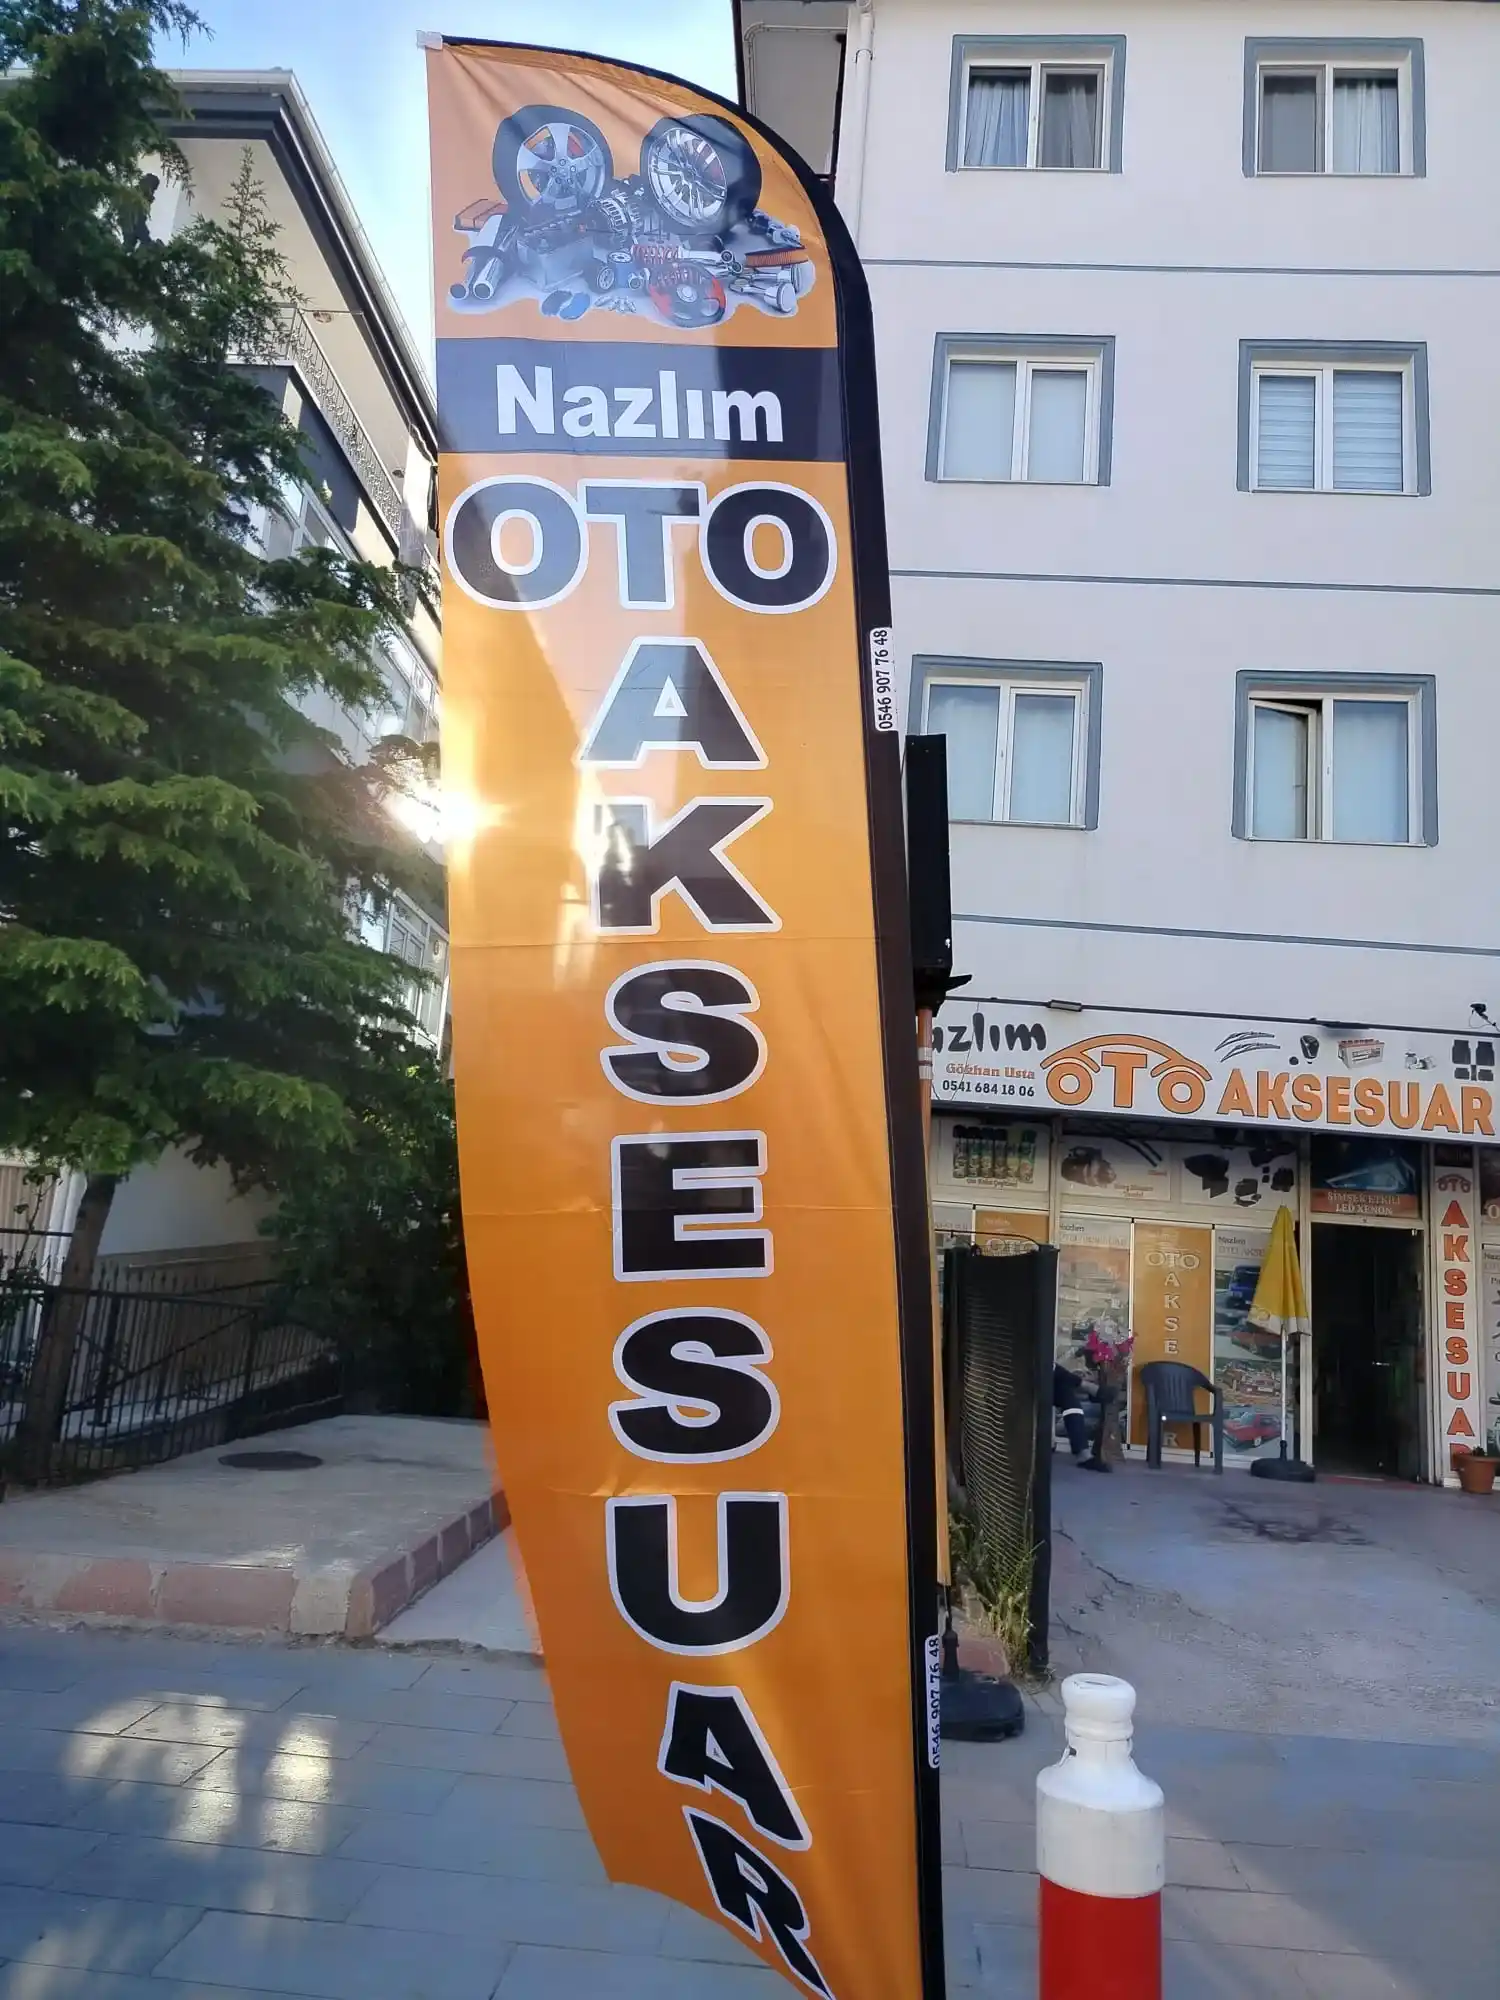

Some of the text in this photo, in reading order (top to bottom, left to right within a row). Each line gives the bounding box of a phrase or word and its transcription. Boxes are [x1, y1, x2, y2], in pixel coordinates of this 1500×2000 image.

[496, 364, 783, 442] Nazlım
[444, 474, 838, 614] OTO
[873, 629, 893, 729] 0546 907 76 48
[942, 1080, 1035, 1097] 0541 684 18 06
[946, 1063, 1035, 1079] Gökhan Usta
[1046, 1050, 1206, 1114] OTO
[1216, 1068, 1496, 1136] AKSESUAR
[1145, 1250, 1200, 1270] OTO
[574, 636, 837, 2000] AKSESUAR
